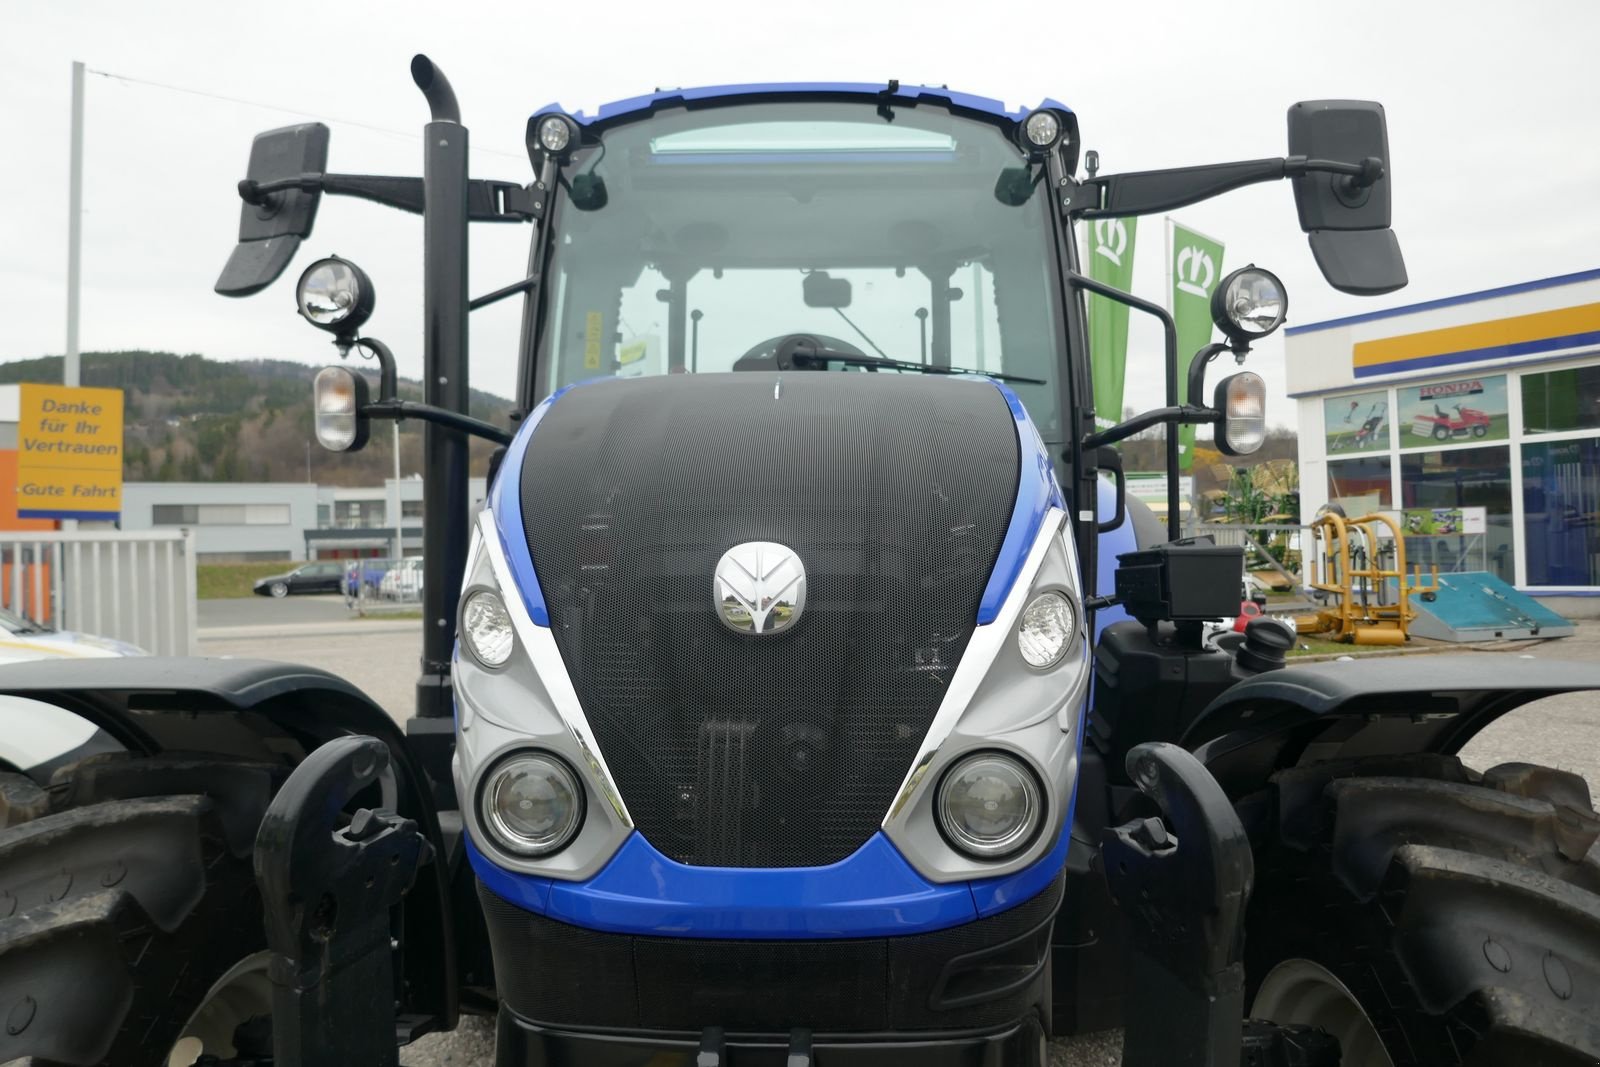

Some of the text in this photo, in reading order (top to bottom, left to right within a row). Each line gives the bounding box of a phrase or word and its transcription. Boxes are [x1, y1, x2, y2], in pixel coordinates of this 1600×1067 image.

[1420, 380, 1482, 397] HONDA
[42, 399, 102, 415] Danke
[40, 418, 101, 435] für Ihr
[24, 438, 118, 455] Vertrauen
[22, 483, 117, 497] Gute Fahrt
